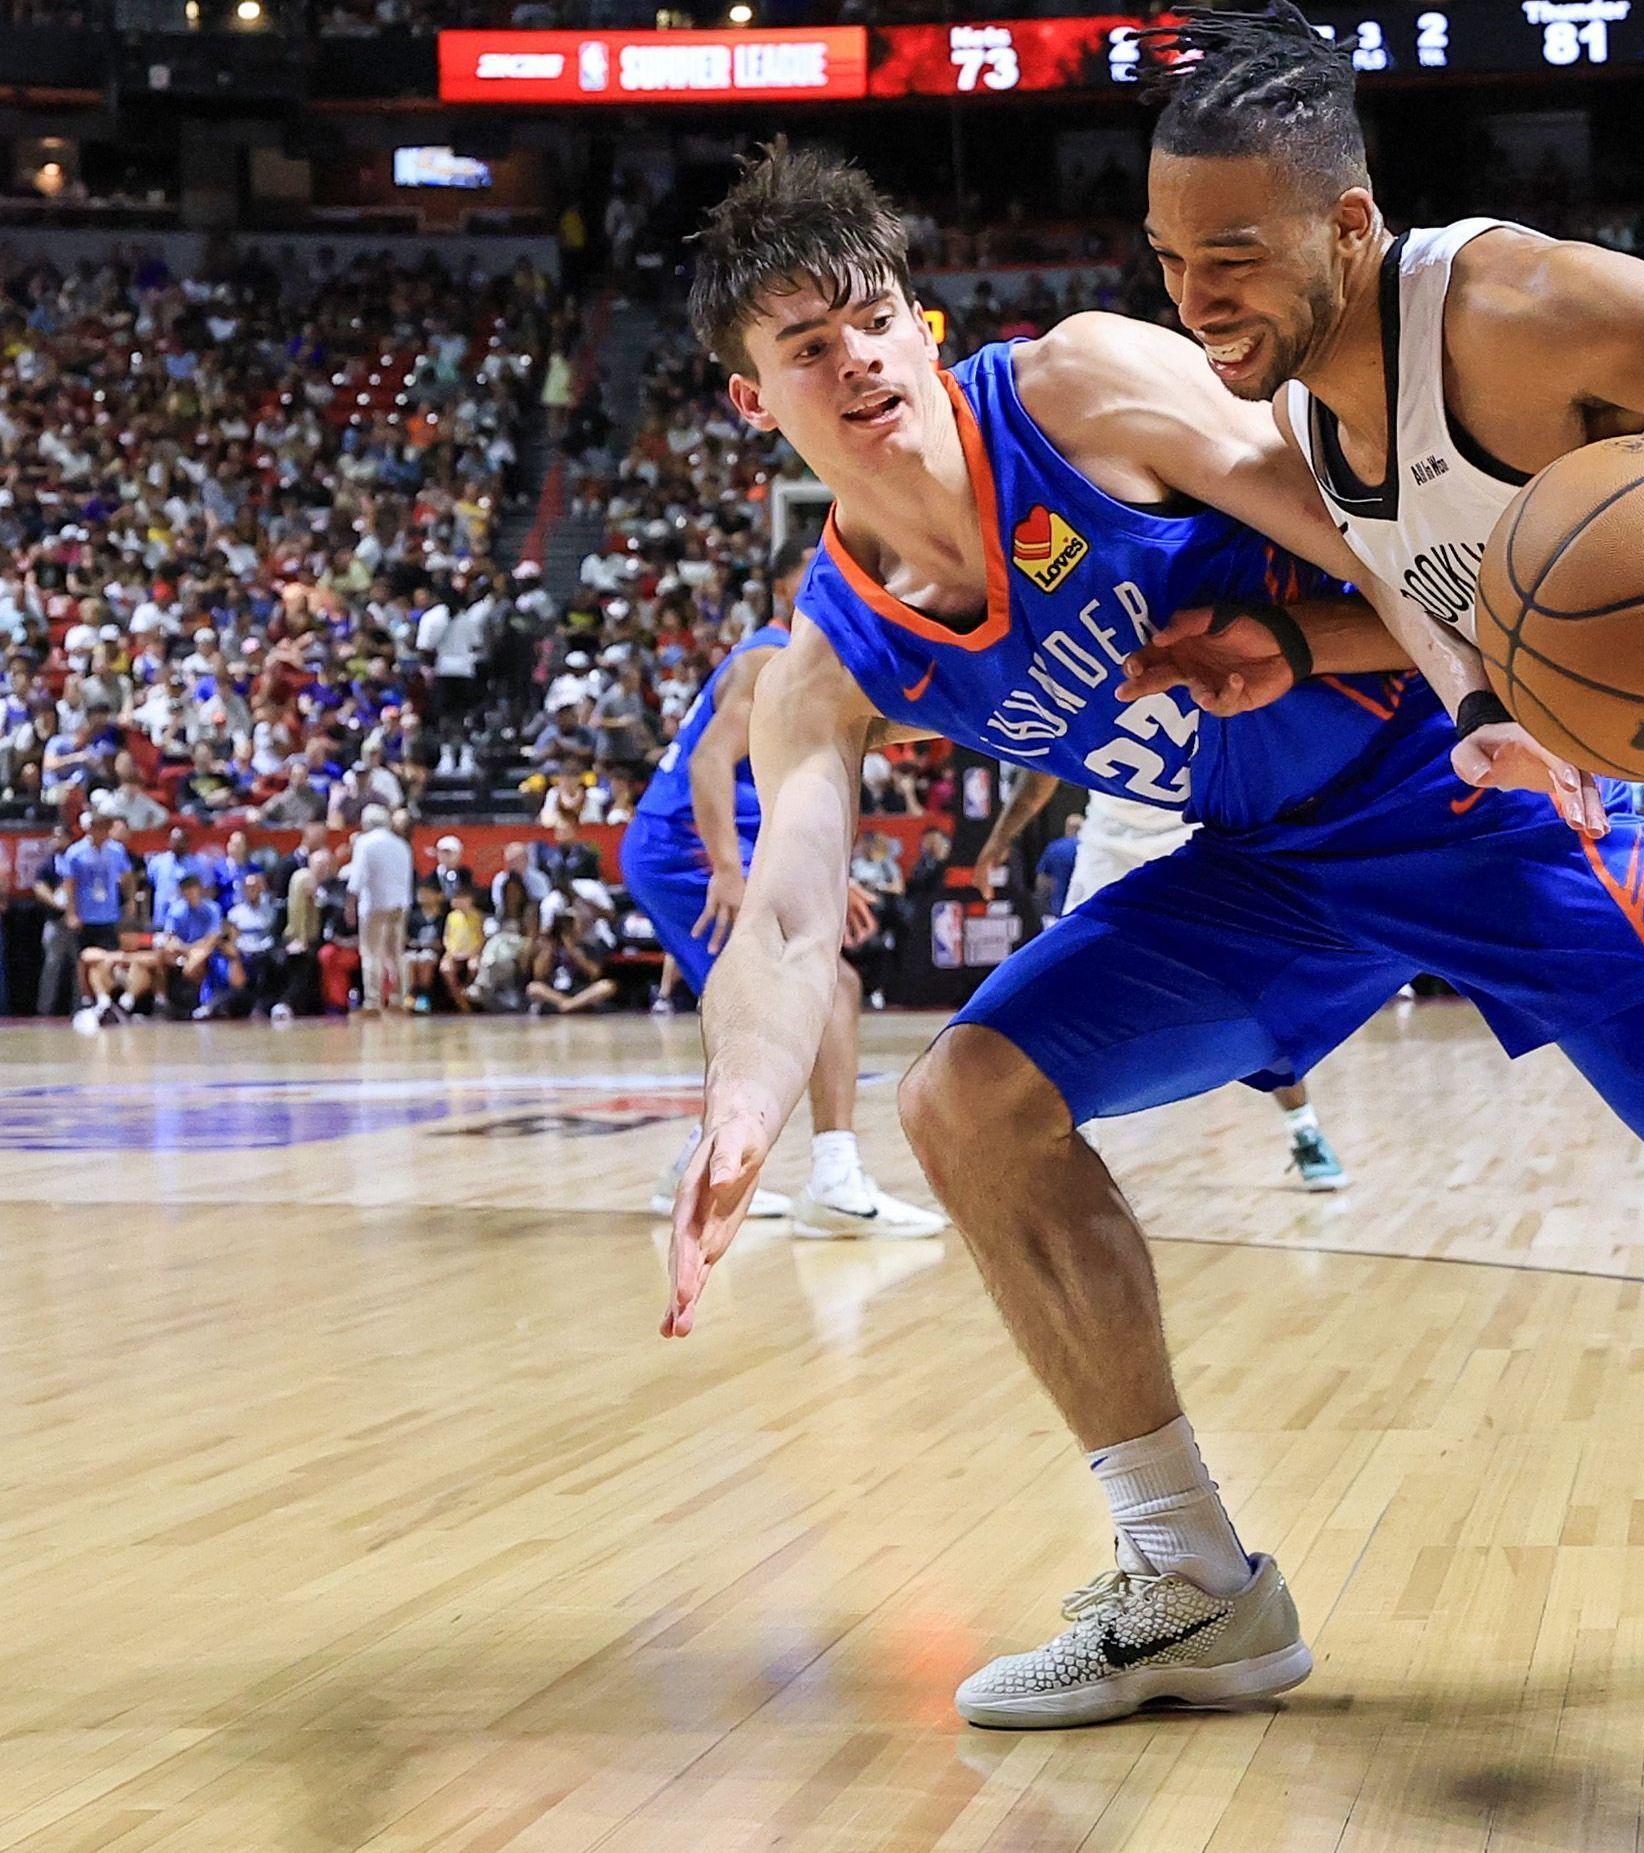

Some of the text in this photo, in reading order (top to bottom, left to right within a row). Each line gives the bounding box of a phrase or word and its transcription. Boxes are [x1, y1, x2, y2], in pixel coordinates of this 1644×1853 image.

[1417, 12, 1448, 48] 2
[1543, 20, 1608, 65] 81
[733, 42, 828, 87] LEAGUE
[951, 47, 1019, 91] 73
